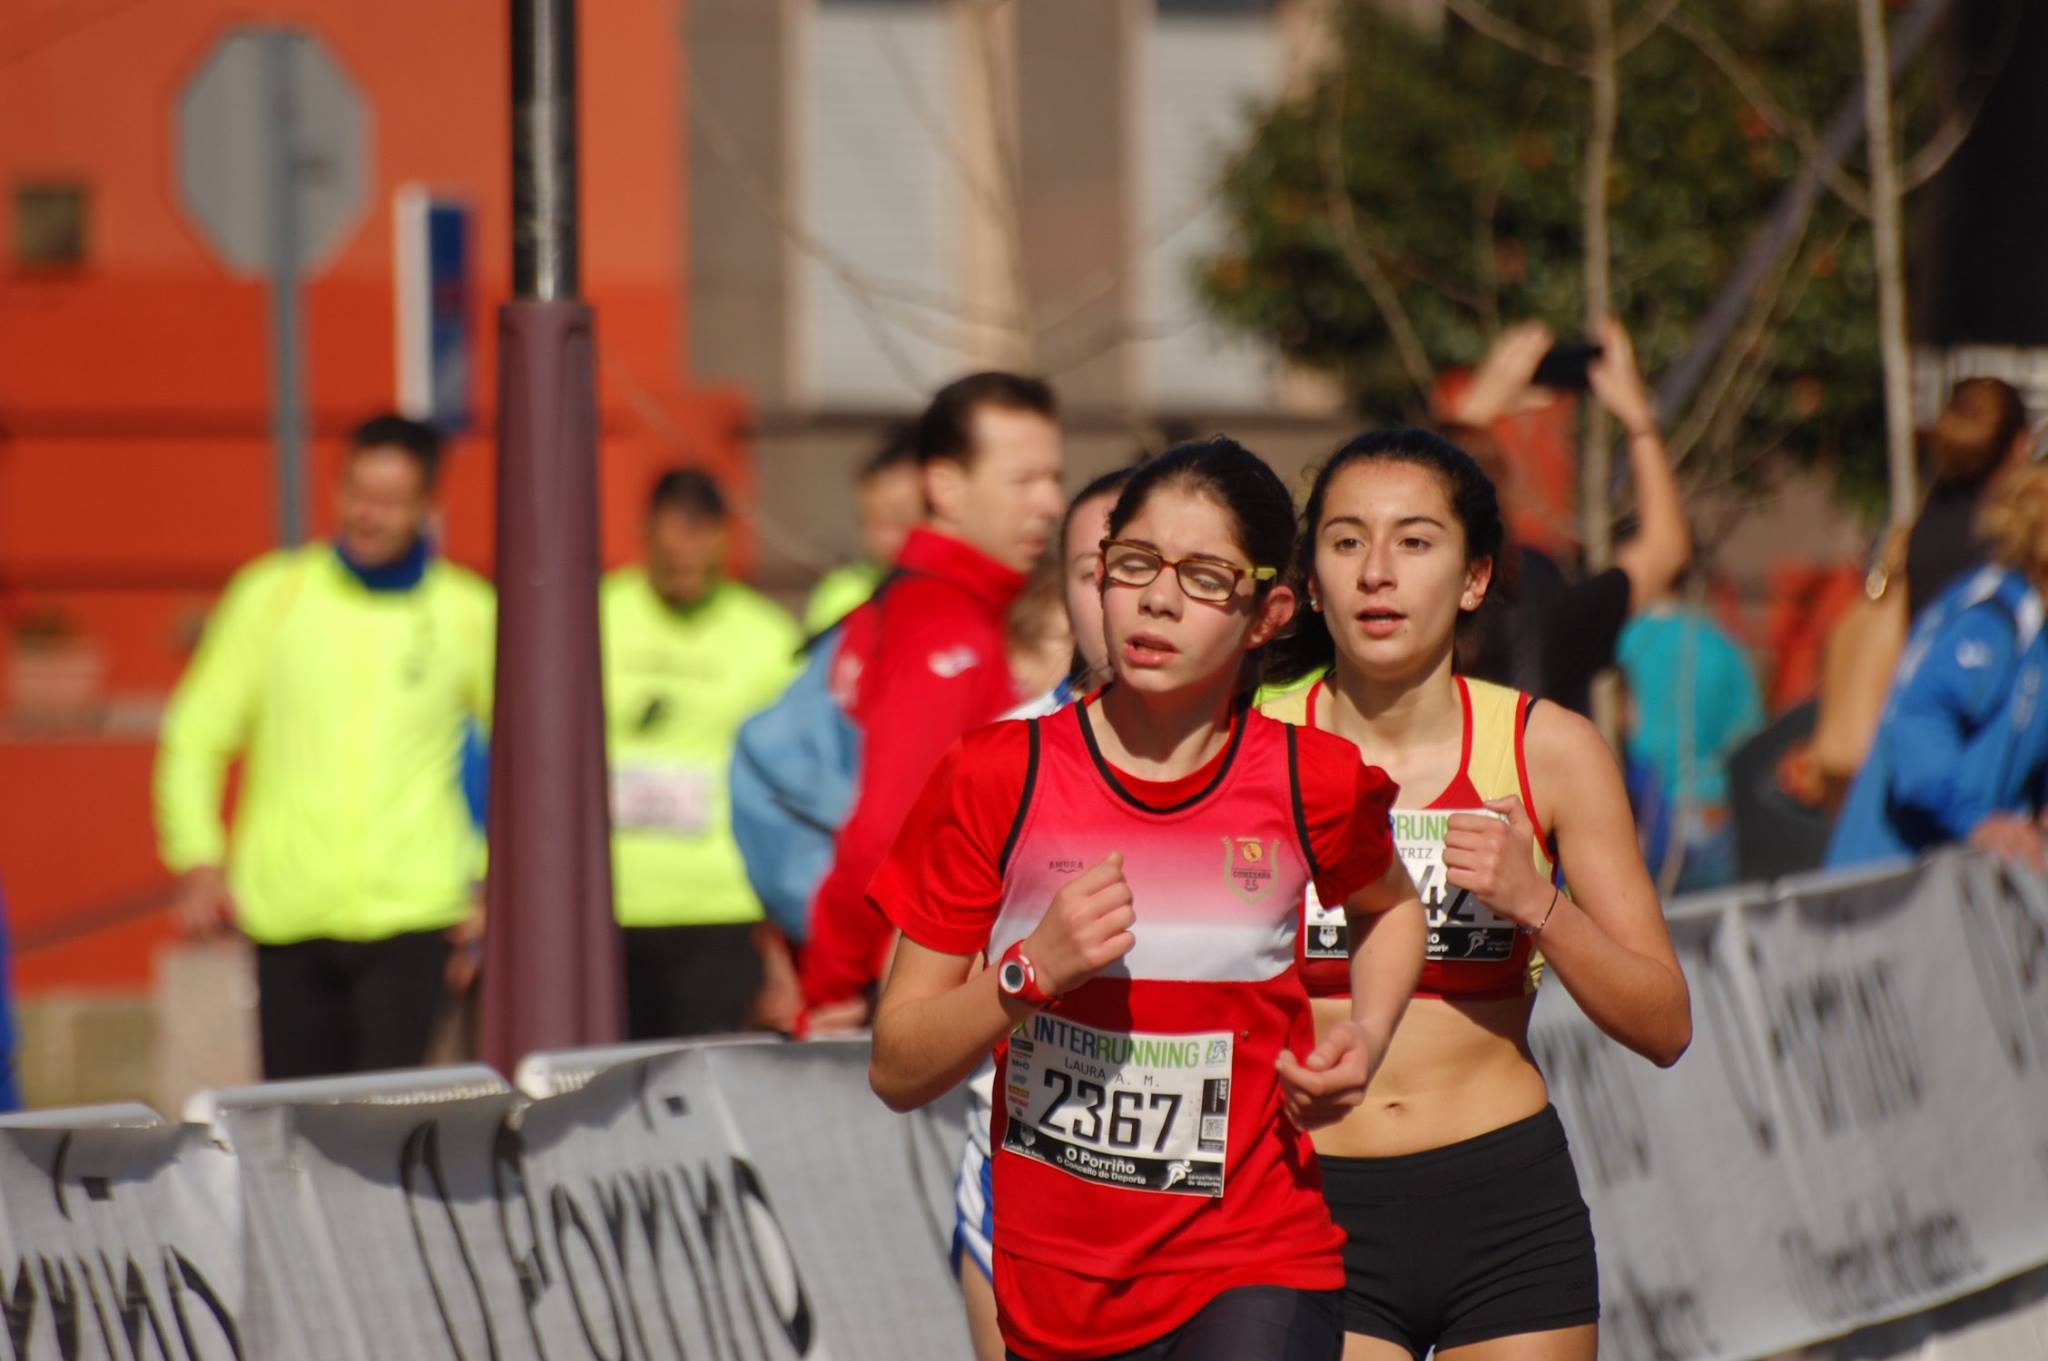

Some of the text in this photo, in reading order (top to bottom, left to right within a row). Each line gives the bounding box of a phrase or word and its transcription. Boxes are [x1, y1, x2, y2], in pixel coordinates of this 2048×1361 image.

[1034, 1014, 1200, 1069] INTERRUNNING
[1064, 1057, 1160, 1088] LAURA A. M.
[1039, 1068, 1183, 1154] 2367
[1064, 1159, 1098, 1177] Concello
[1111, 1172, 1147, 1185] Deporte
[1065, 1147, 1078, 1161] O
[1080, 1151, 1136, 1175] Porriño
